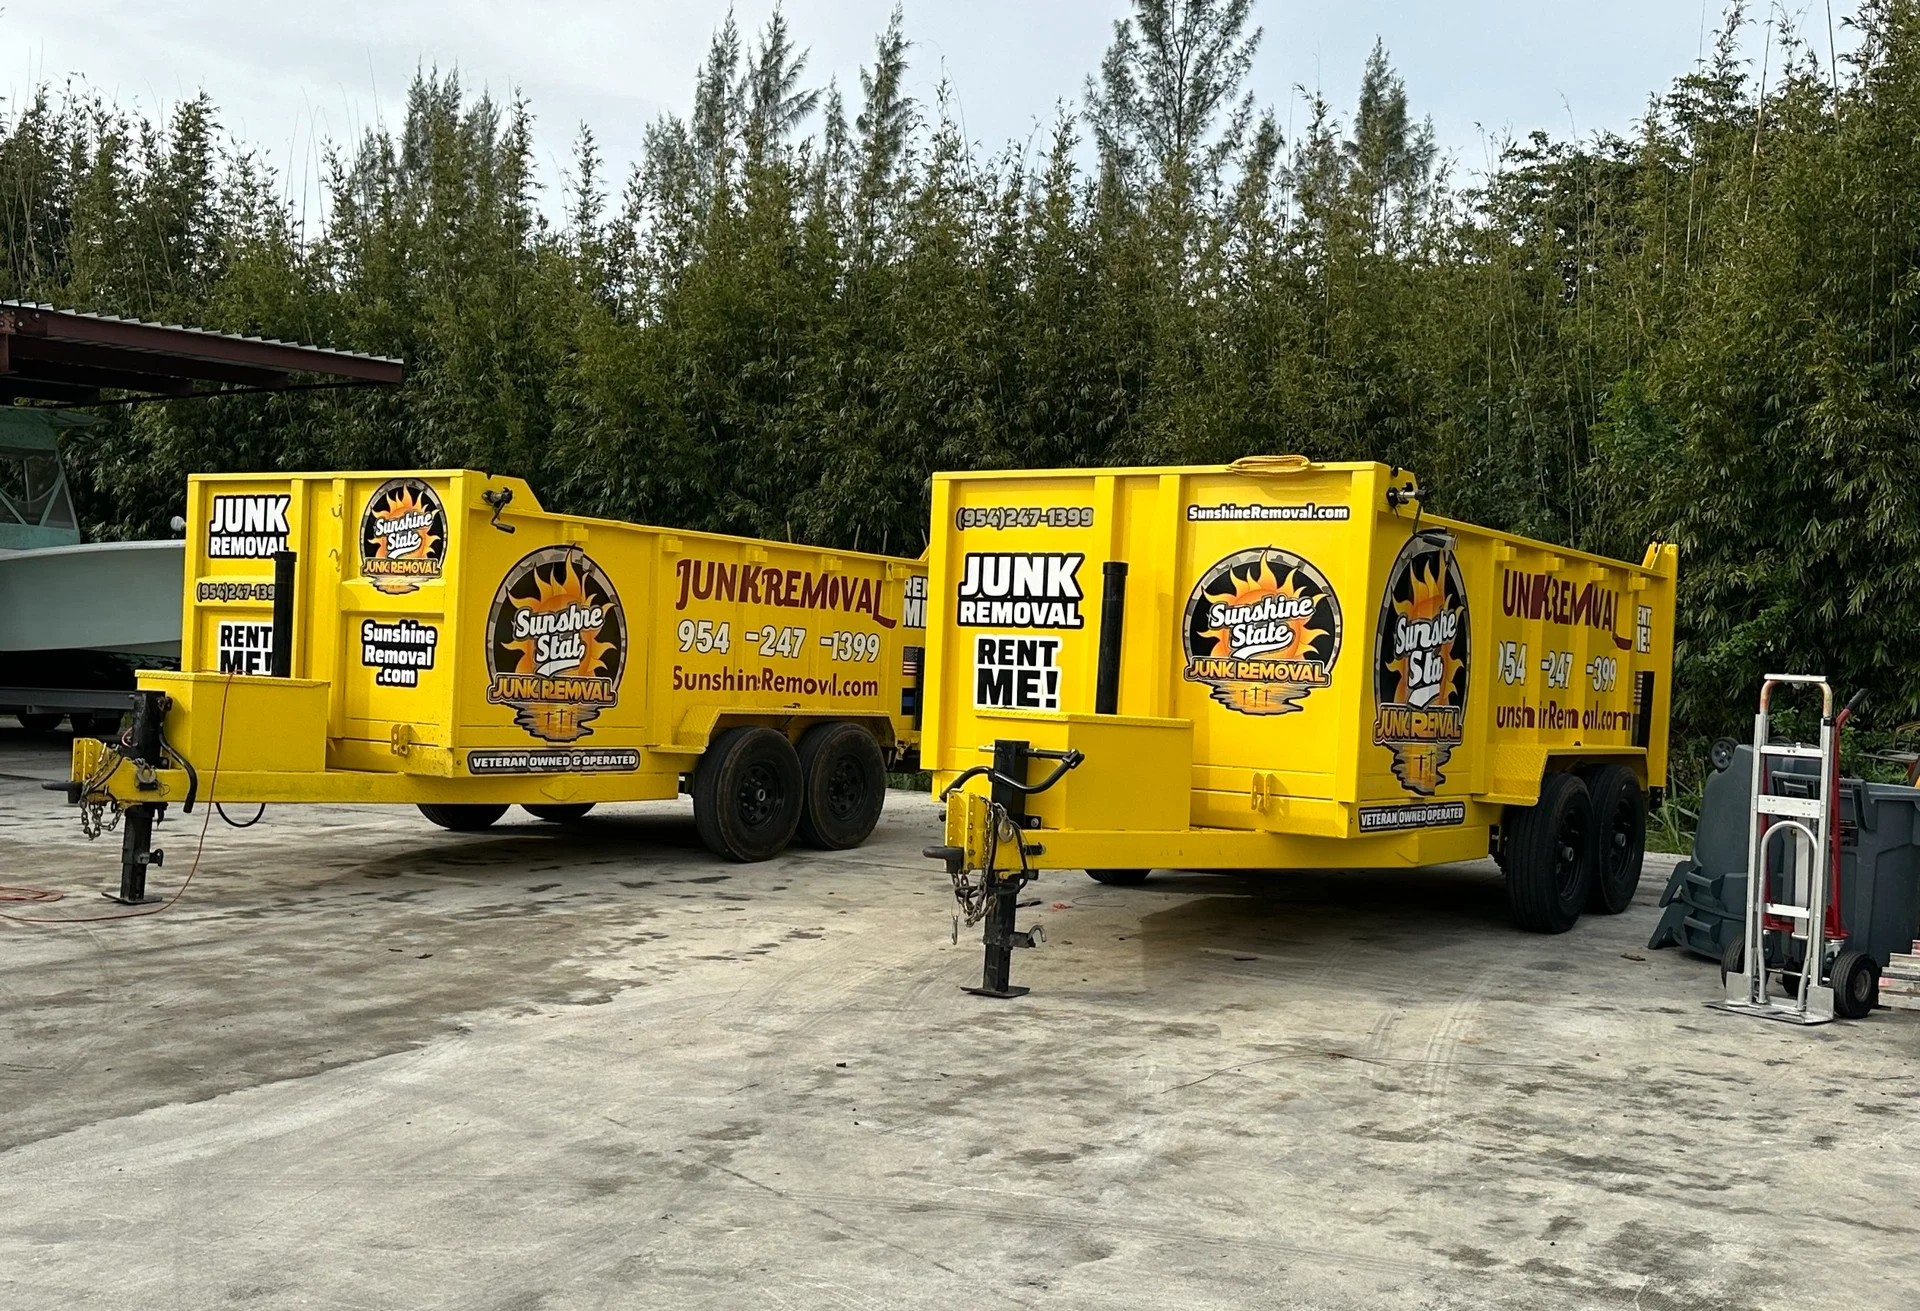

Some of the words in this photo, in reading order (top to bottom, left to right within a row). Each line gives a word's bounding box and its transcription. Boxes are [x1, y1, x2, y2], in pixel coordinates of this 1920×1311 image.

[211, 498, 289, 532] JUNK
[956, 507, 1094, 530] (954)247-1399
[1189, 504, 1349, 520] SunshineRemoval.com
[375, 512, 434, 536] Sunshine
[210, 536, 286, 556] REMOVAL
[387, 532, 421, 551] State
[363, 561, 390, 574] JUNK
[391, 561, 440, 575] REMOVAL
[961, 556, 1081, 597] JUNK
[197, 583, 275, 602] (954)247-139
[960, 601, 1081, 625] REMOVAL
[1210, 596, 1314, 627] Sunshine
[221, 625, 272, 648] RENT
[364, 623, 435, 644] Sunshine
[678, 619, 730, 654] 954
[1231, 622, 1294, 648] State
[364, 645, 432, 666] Removal
[977, 638, 1058, 667] RENT
[378, 669, 415, 684] .com
[1189, 660, 1235, 678] JUNK
[1237, 660, 1326, 682] REMOVAL
[493, 679, 539, 699] JUNK
[977, 668, 1058, 708] ME!
[1378, 710, 1410, 738] JUNK
[472, 756, 527, 768] VETERAN
[529, 755, 570, 767] OWNED
[572, 756, 581, 766] &
[582, 754, 637, 766] OPERATED
[1360, 809, 1398, 826] VETERAN
[1399, 808, 1427, 824] OWNED
[1427, 806, 1464, 822] OPERATED
